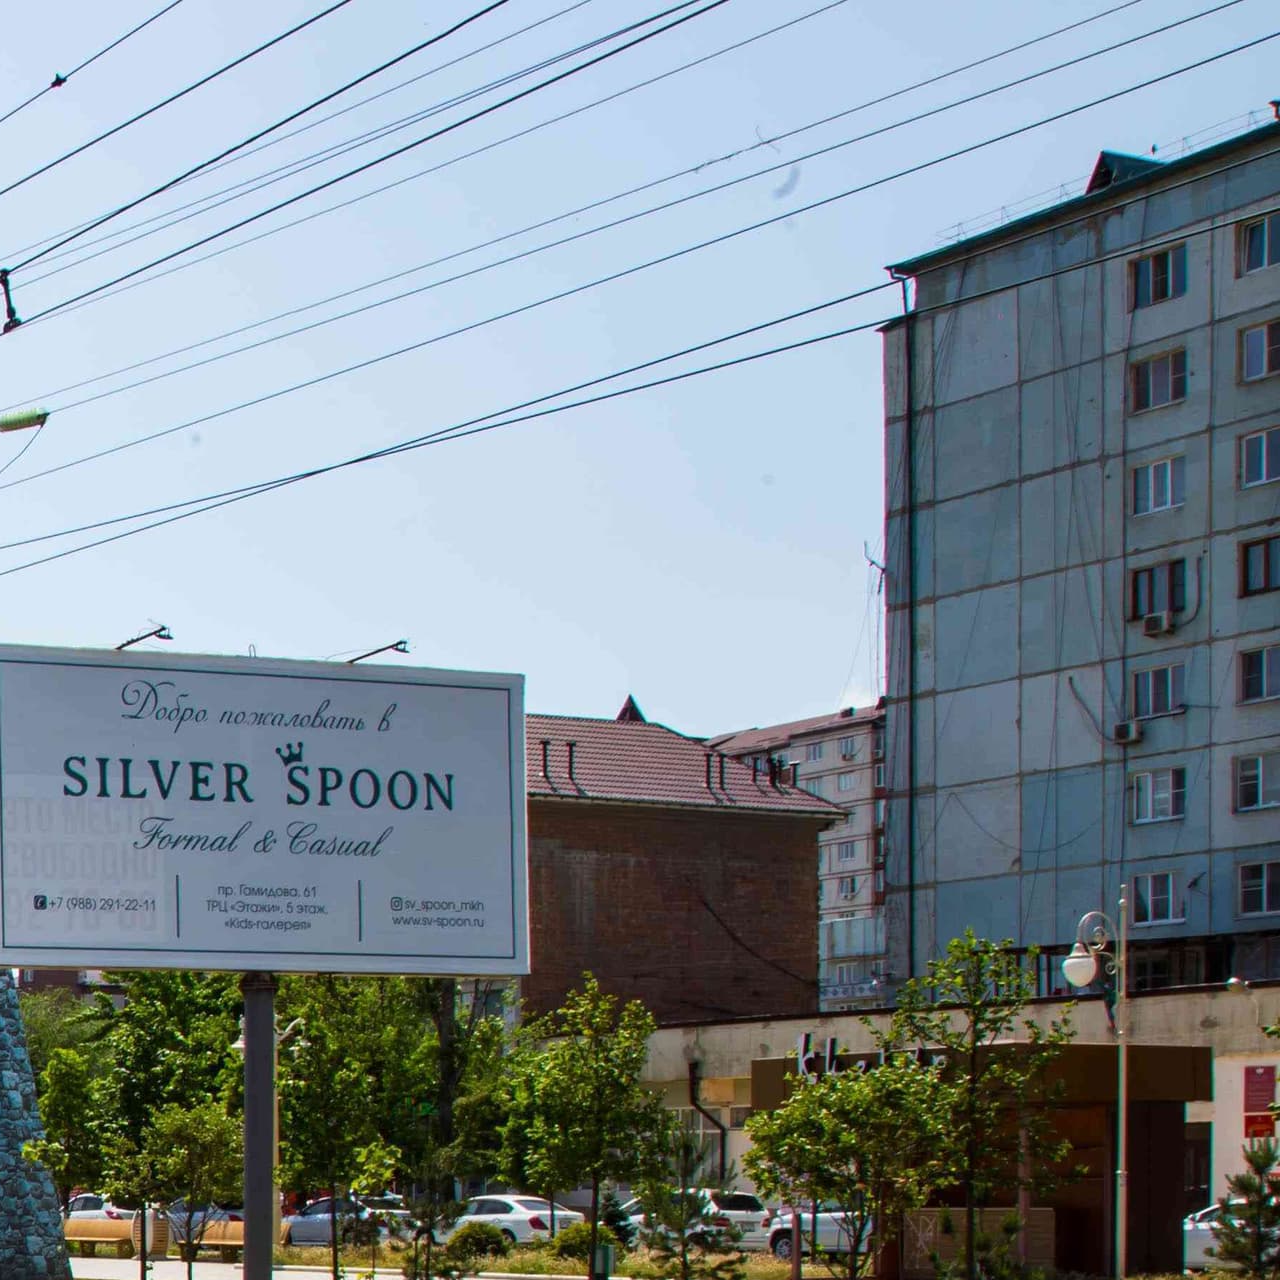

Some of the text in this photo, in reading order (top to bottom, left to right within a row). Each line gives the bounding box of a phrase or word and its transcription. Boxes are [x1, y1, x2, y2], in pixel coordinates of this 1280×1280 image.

[121, 680, 397, 733] Добро пожаловать в
[63, 756, 454, 811] SILVER SPOON
[133, 817, 394, 858] Formal & Casual
[217, 885, 237, 897] пр.
[304, 886, 317, 897] 61
[48, 896, 156, 911] +7 (988) 291-22-11
[206, 901, 228, 914] ТРЦ
[286, 903, 293, 913] 5
[405, 900, 484, 913] sv_spoon_mkh
[224, 918, 312, 932] «Kids-галерея»
[392, 916, 484, 929] www.sv-spoon.ru
